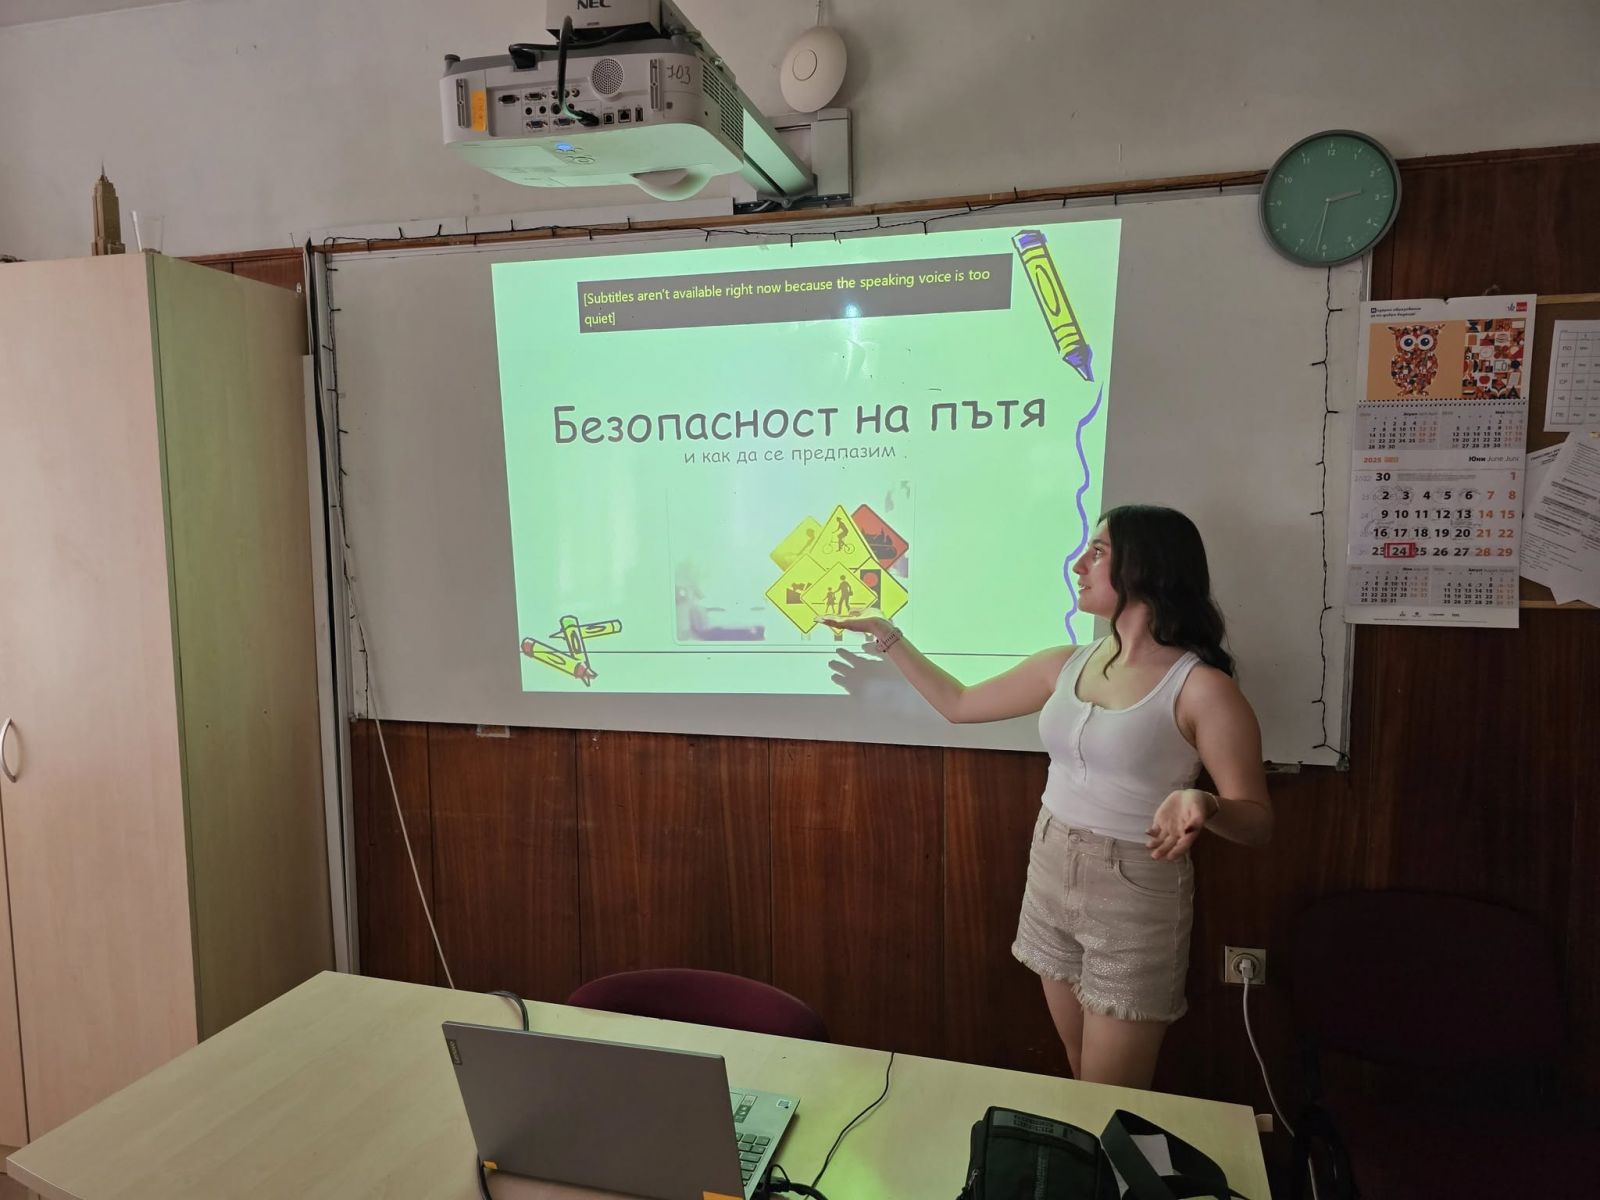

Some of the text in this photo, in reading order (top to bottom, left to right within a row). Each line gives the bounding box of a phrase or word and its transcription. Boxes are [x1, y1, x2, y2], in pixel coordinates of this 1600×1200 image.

[584, 270, 990, 307] [Subtitles aren't available right now because the speaking voice is too
[584, 312, 616, 326] quiet]
[554, 398, 1045, 444] Безопасност на пътя
[684, 446, 896, 466] и как да се предпазим
[1376, 473, 1390, 481] 30
[1382, 492, 1516, 500] 2 3 4 5 6 7 8
[1382, 511, 1515, 519] 9 10 11 12 13 14 15
[1374, 529, 1514, 537] 16 17 18 19 20 21 22
[1392, 547, 1407, 556] 24
[1433, 547, 1448, 556] 26
[1454, 547, 1469, 556] 27
[1475, 547, 1490, 556] 28
[1498, 547, 1513, 556] 29
